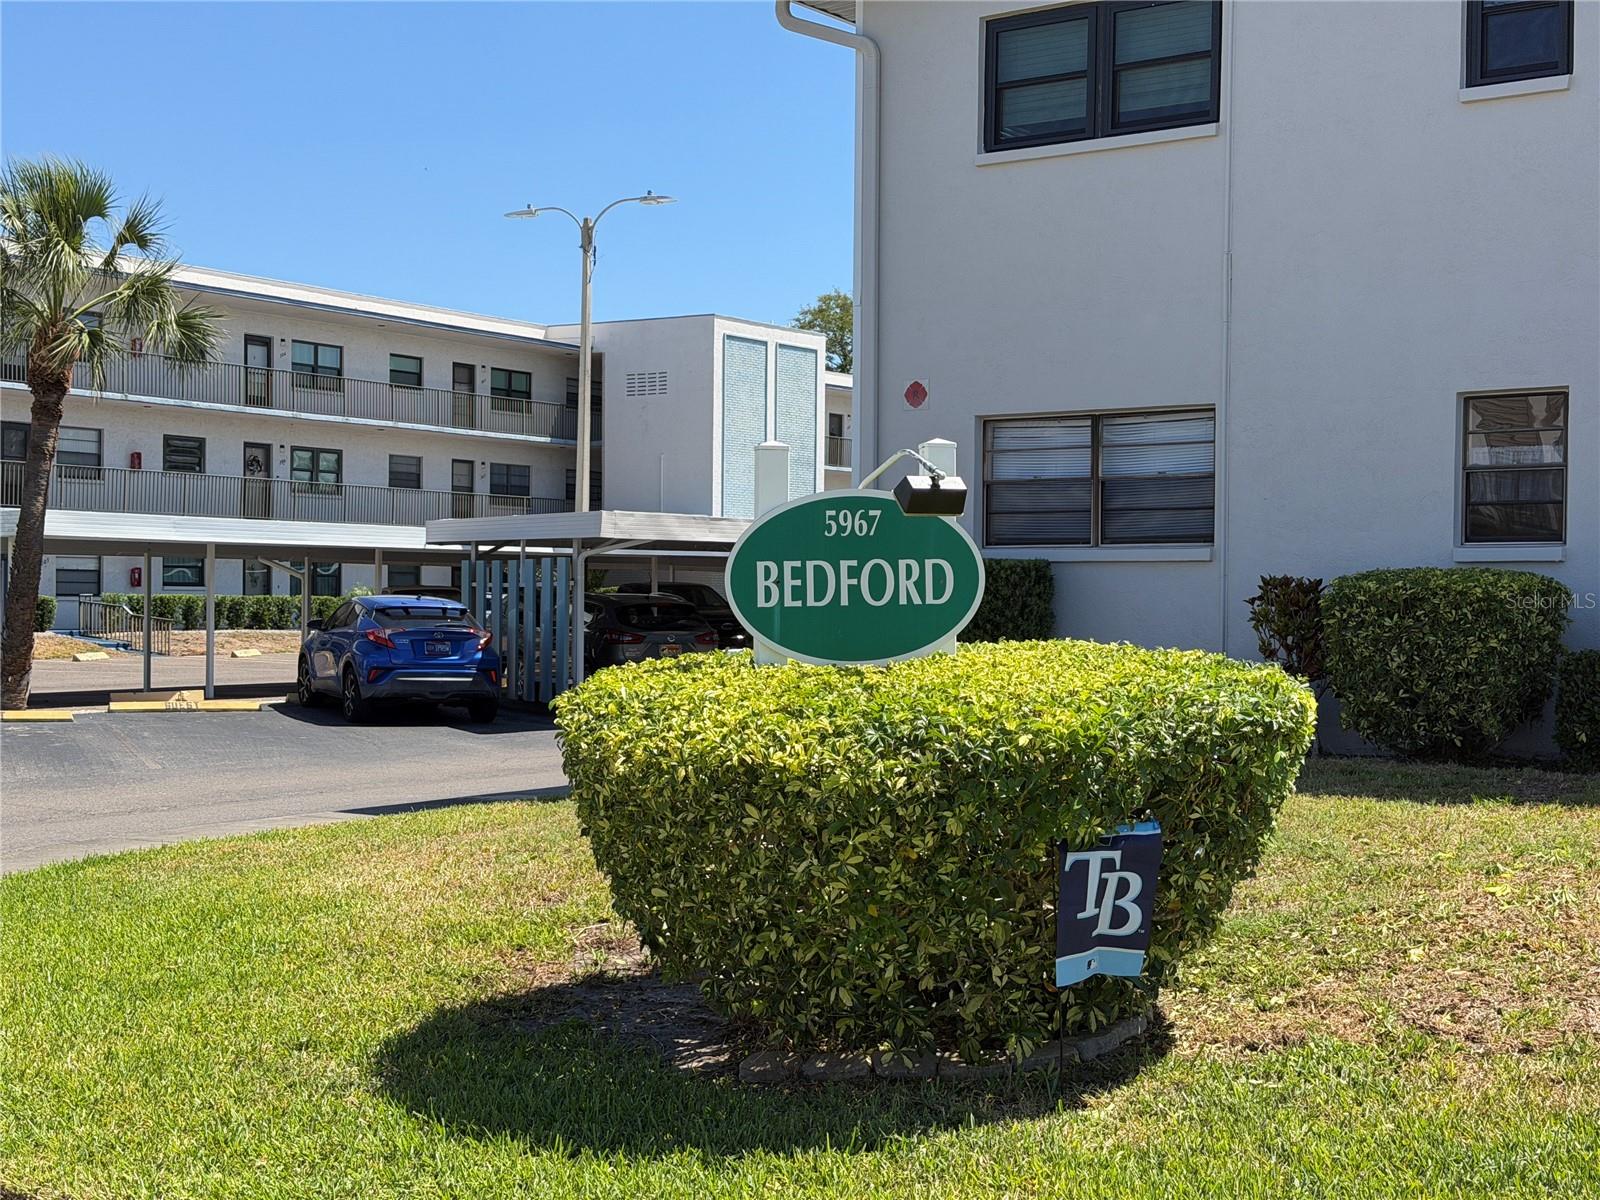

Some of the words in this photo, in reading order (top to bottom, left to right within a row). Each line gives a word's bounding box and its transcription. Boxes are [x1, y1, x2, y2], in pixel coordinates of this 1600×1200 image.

[824, 509, 882, 537] 5967
[756, 558, 954, 608] BEDFORD
[1064, 850, 1142, 937] TB
